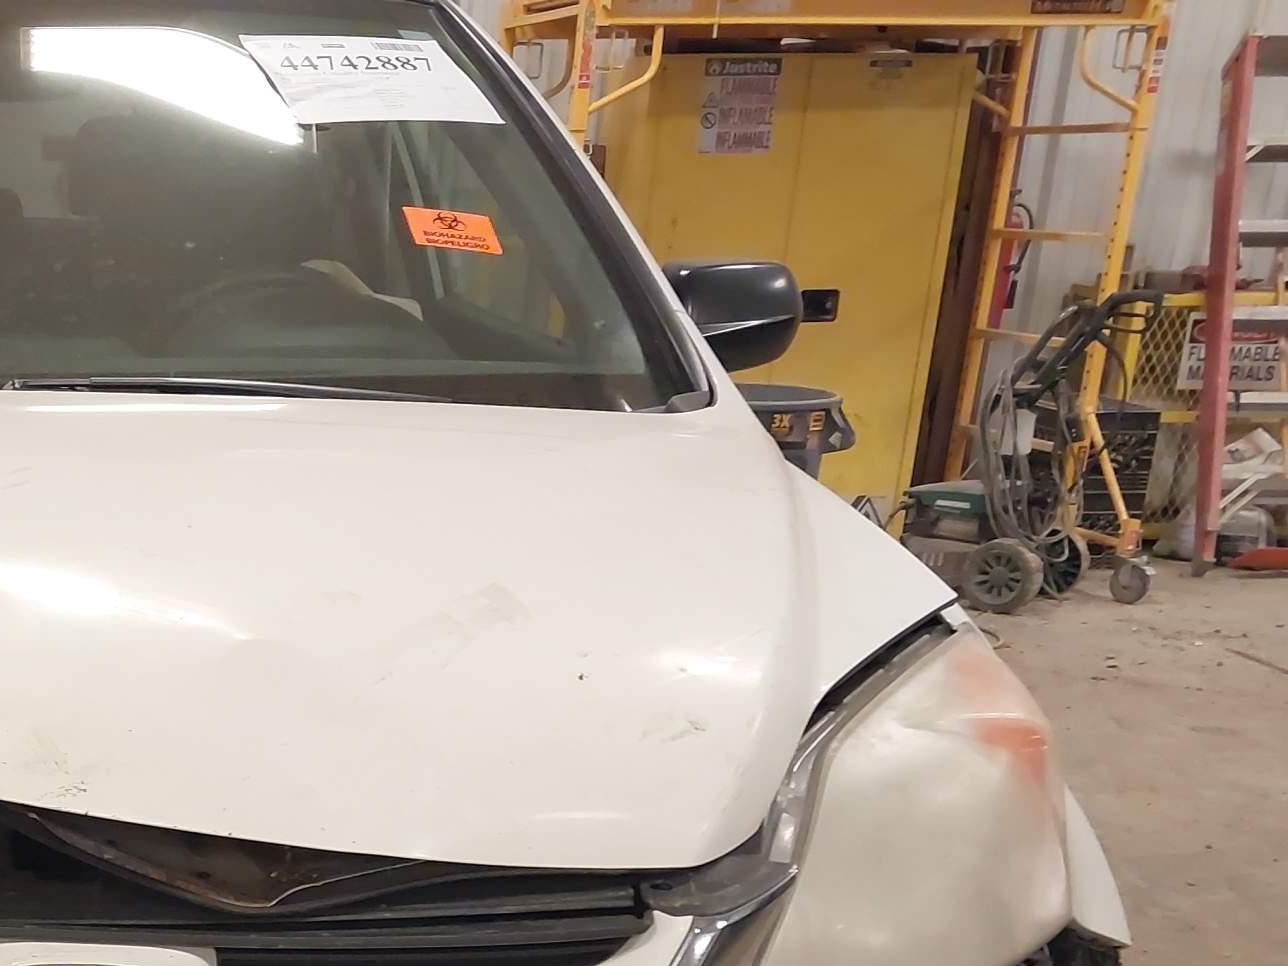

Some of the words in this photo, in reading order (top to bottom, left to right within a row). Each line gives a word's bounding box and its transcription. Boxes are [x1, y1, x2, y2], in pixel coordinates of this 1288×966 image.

[280, 55, 433, 72] 44742887
[1188, 345, 1281, 362] FLMABLE
[1186, 365, 1275, 381] MRIALS
